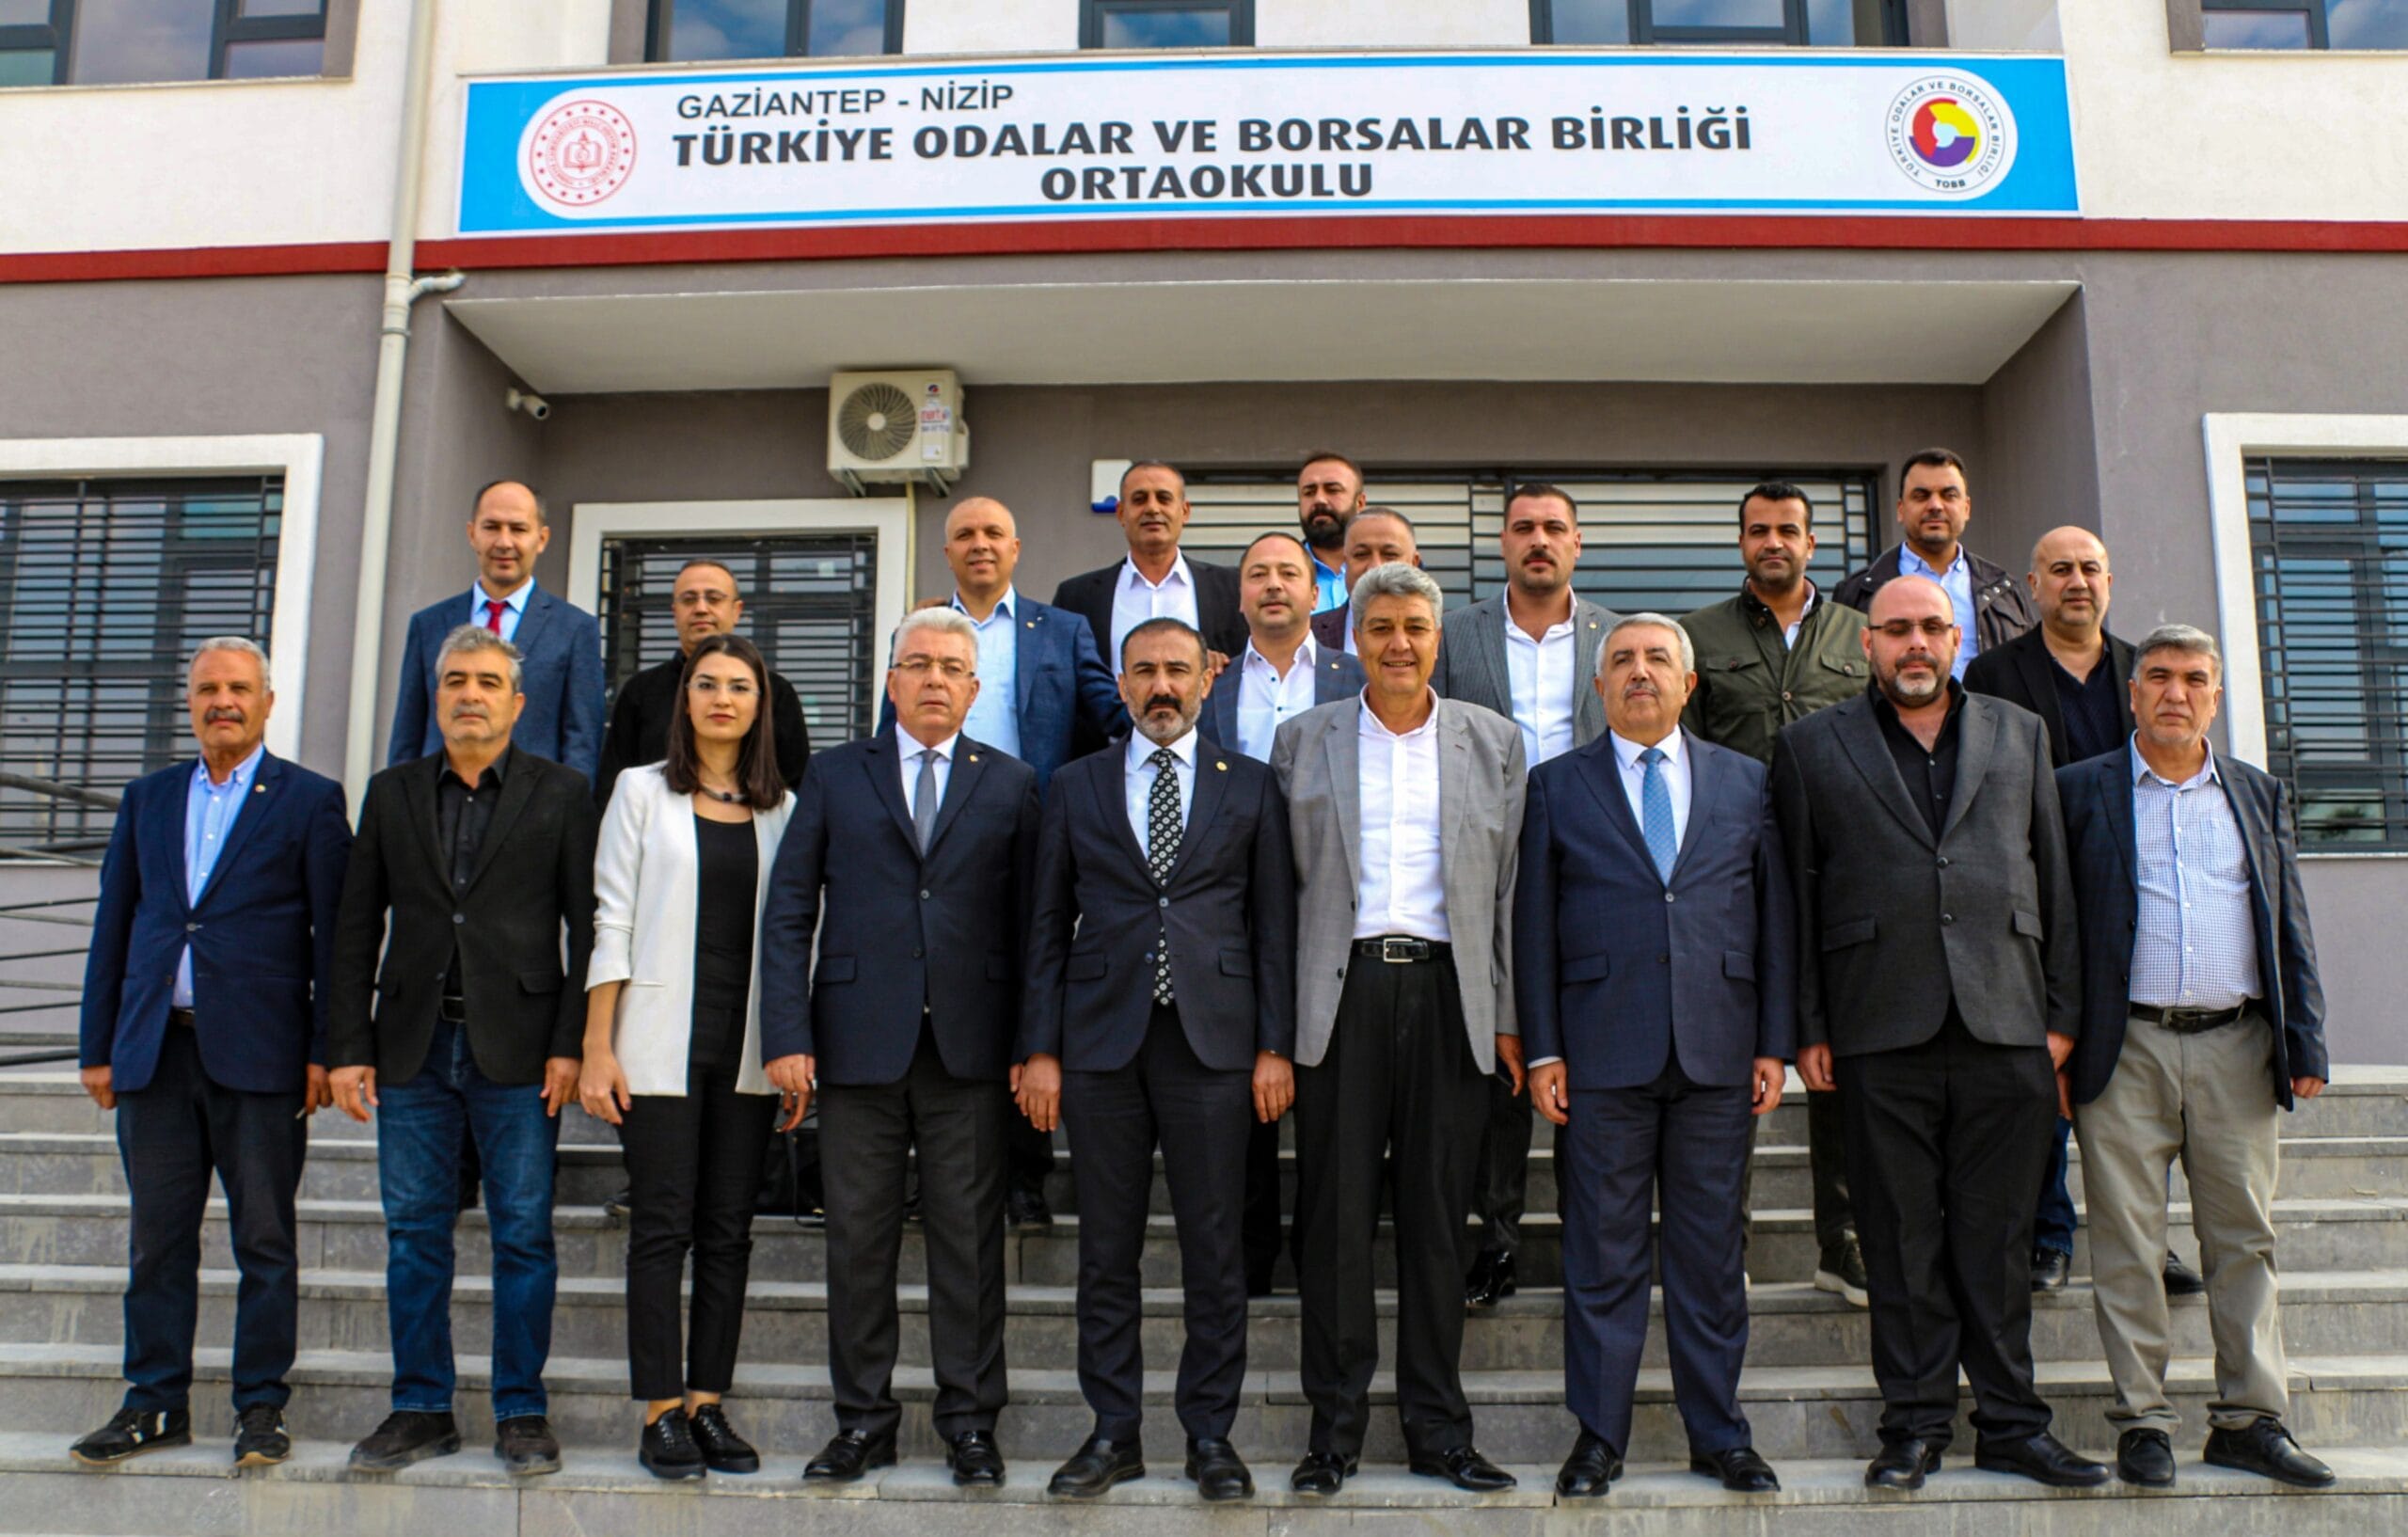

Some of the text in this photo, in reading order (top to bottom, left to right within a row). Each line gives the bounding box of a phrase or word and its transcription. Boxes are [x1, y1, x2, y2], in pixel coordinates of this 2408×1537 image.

[676, 87, 886, 119] GAZİANTEP
[920, 77, 1013, 112] NİZİP
[1893, 85, 1925, 123] ODALAR
[1928, 81, 1944, 89] VE
[1949, 82, 1999, 131] BORSALAR
[672, 105, 1751, 166] TÜRKİYE ODALAR VE BORSALAR BİRLİĞİ
[1040, 164, 1373, 201] ORTAOKULU
[1935, 179, 1966, 188] TOBB
